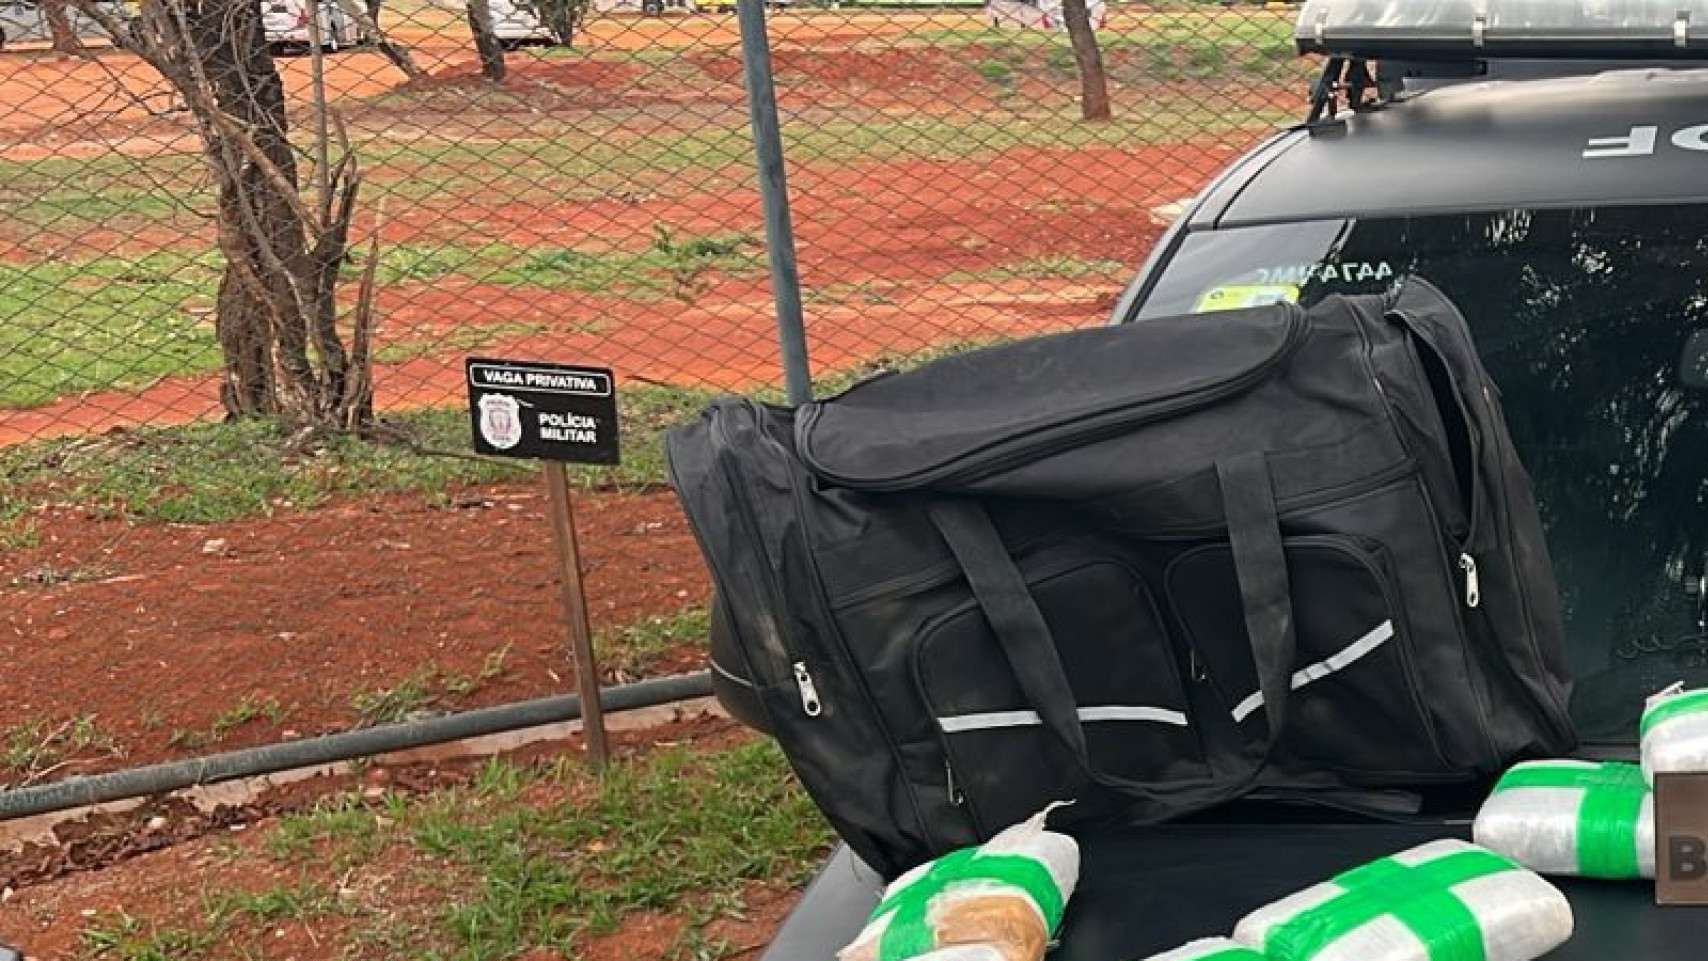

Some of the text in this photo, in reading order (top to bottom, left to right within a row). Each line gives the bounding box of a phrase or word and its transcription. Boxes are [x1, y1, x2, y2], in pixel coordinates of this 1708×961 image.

[482, 368, 597, 391] VAGA PRIVATIVA
[538, 411, 597, 430] POLÍCIA
[539, 427, 597, 443] MILITAR
